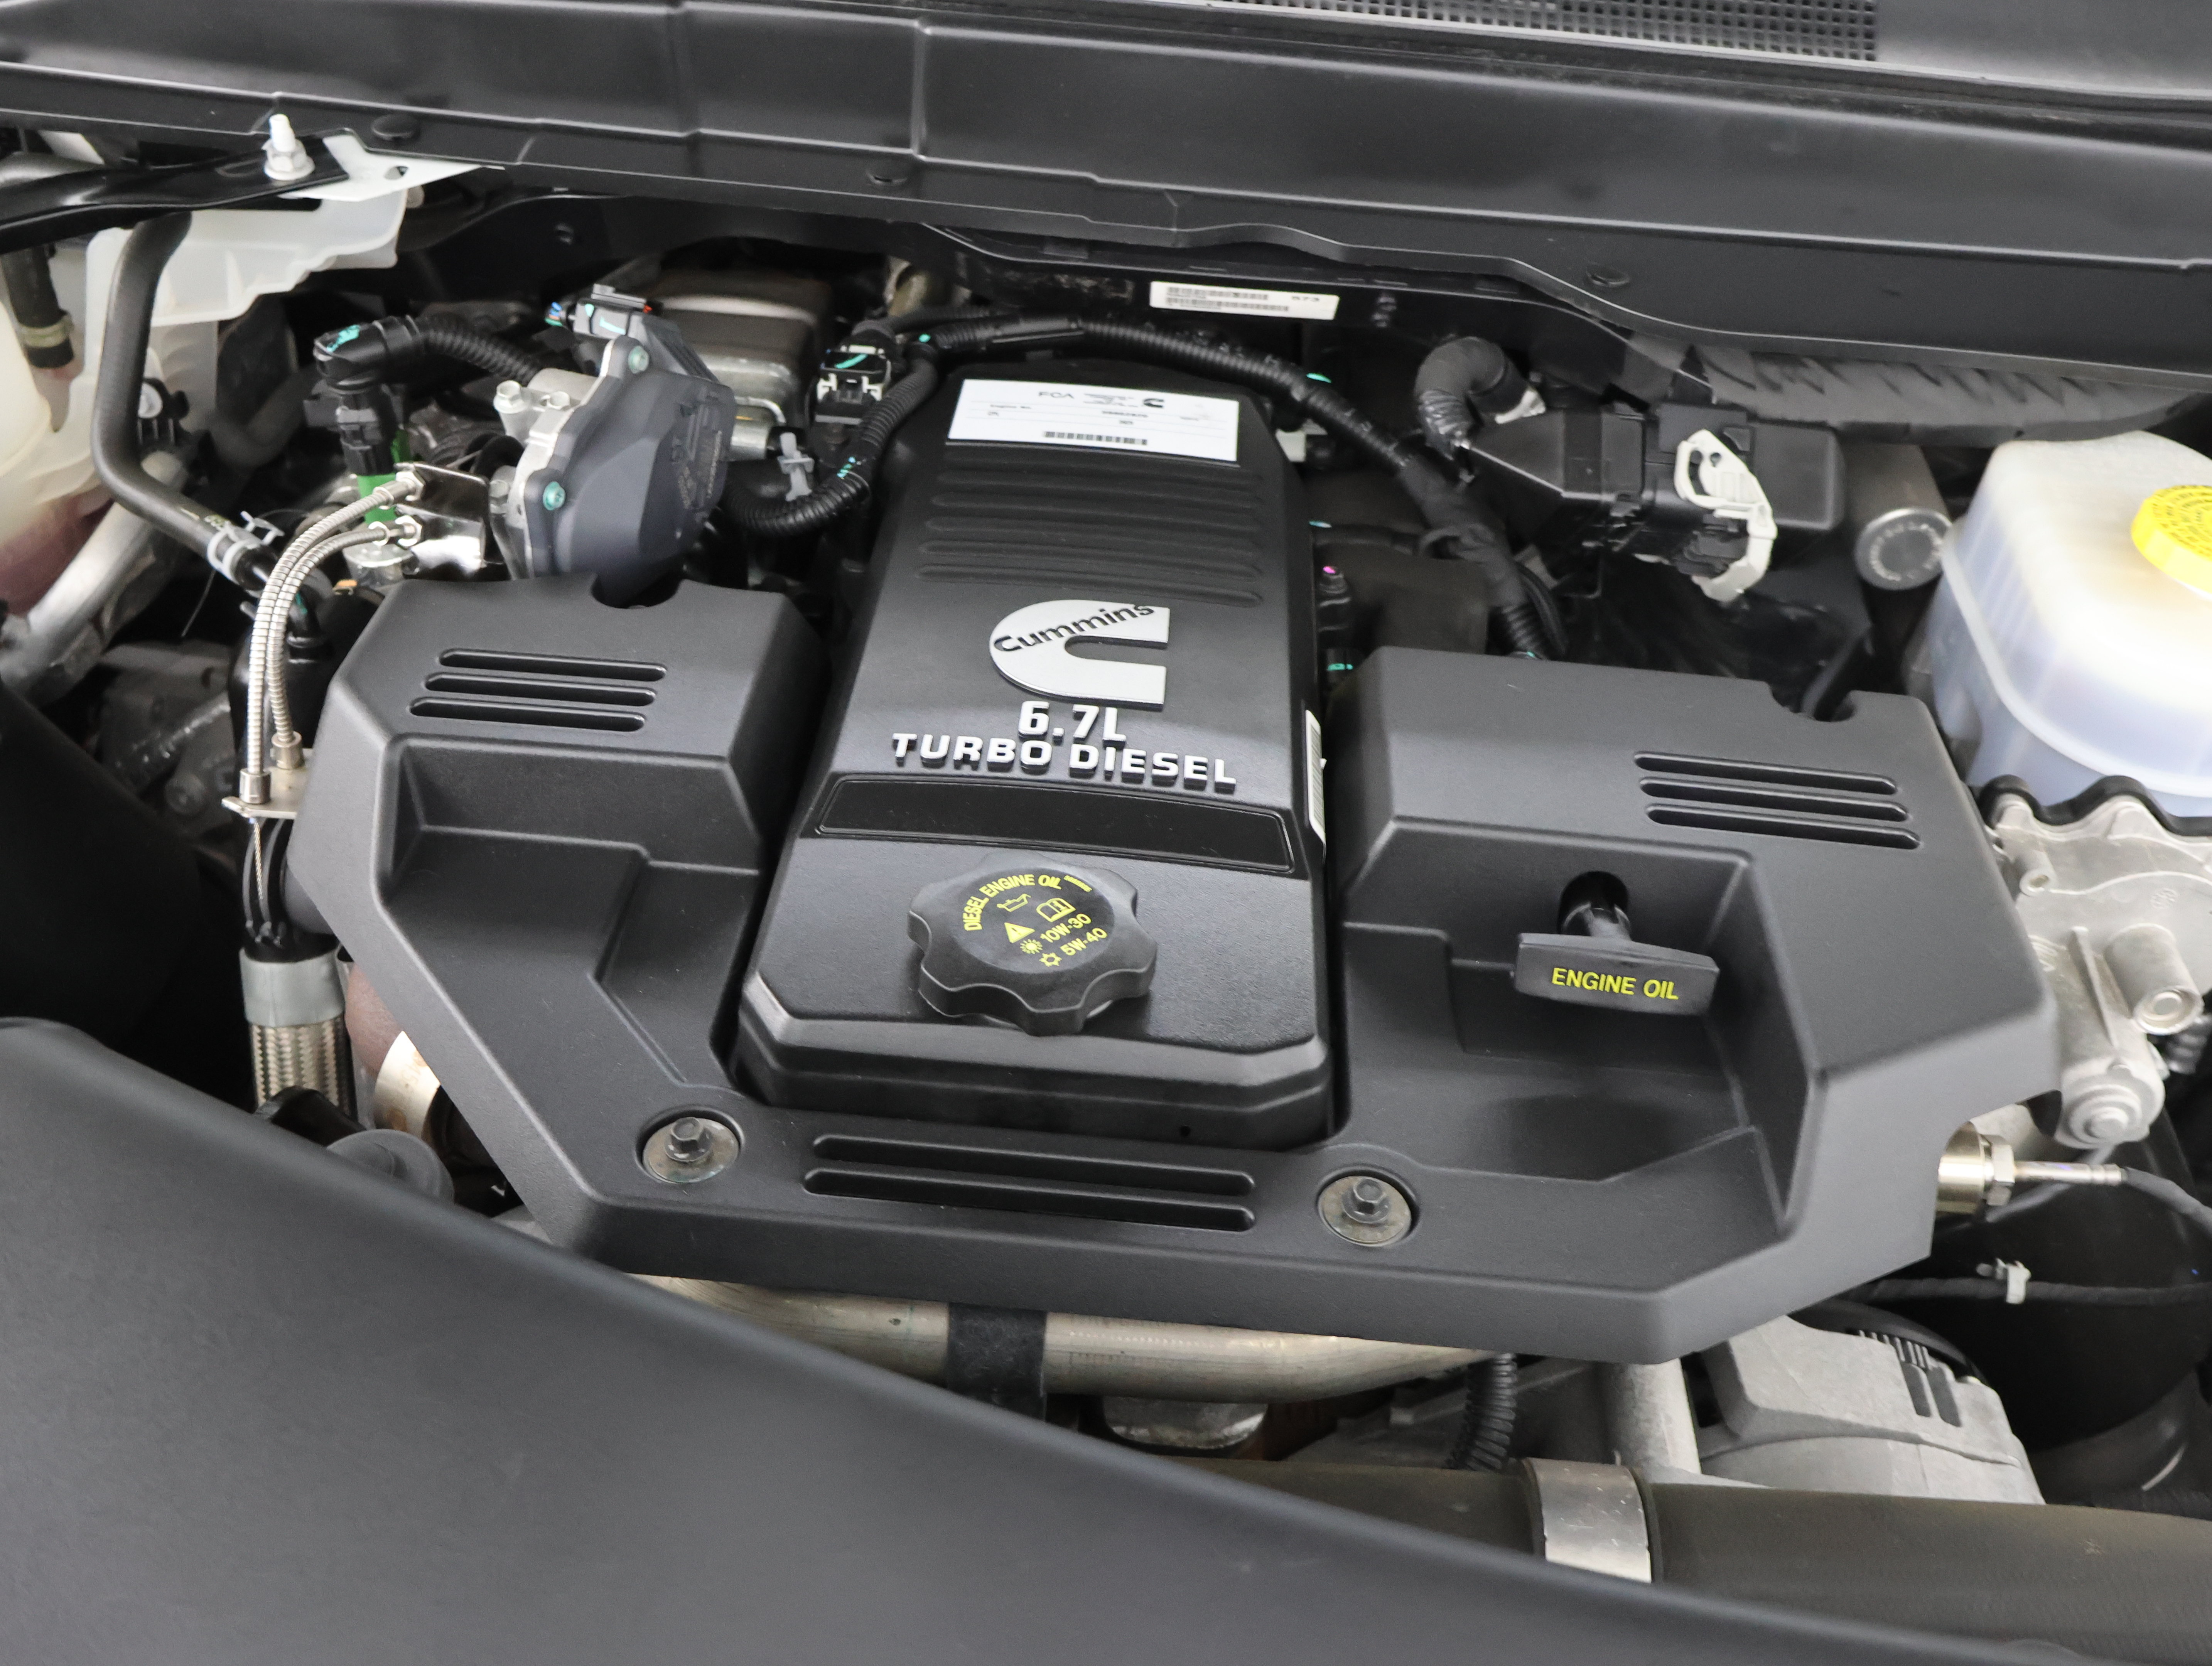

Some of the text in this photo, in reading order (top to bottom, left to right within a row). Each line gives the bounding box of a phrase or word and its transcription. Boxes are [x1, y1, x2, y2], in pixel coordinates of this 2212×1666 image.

[1039, 391, 1074, 399] FCA
[994, 605, 1154, 652] Cummins
[1017, 700, 1126, 746] 6.7L
[892, 733, 1237, 793] TURBO DIESEL
[963, 896, 990, 931] DIESEL
[979, 874, 1036, 898] ENGINE
[1038, 874, 1062, 890] OIL
[1040, 913, 1092, 943] 10W-30
[1060, 927, 1107, 956] 5W-40
[1551, 967, 1679, 1000] ENGINE OIL
